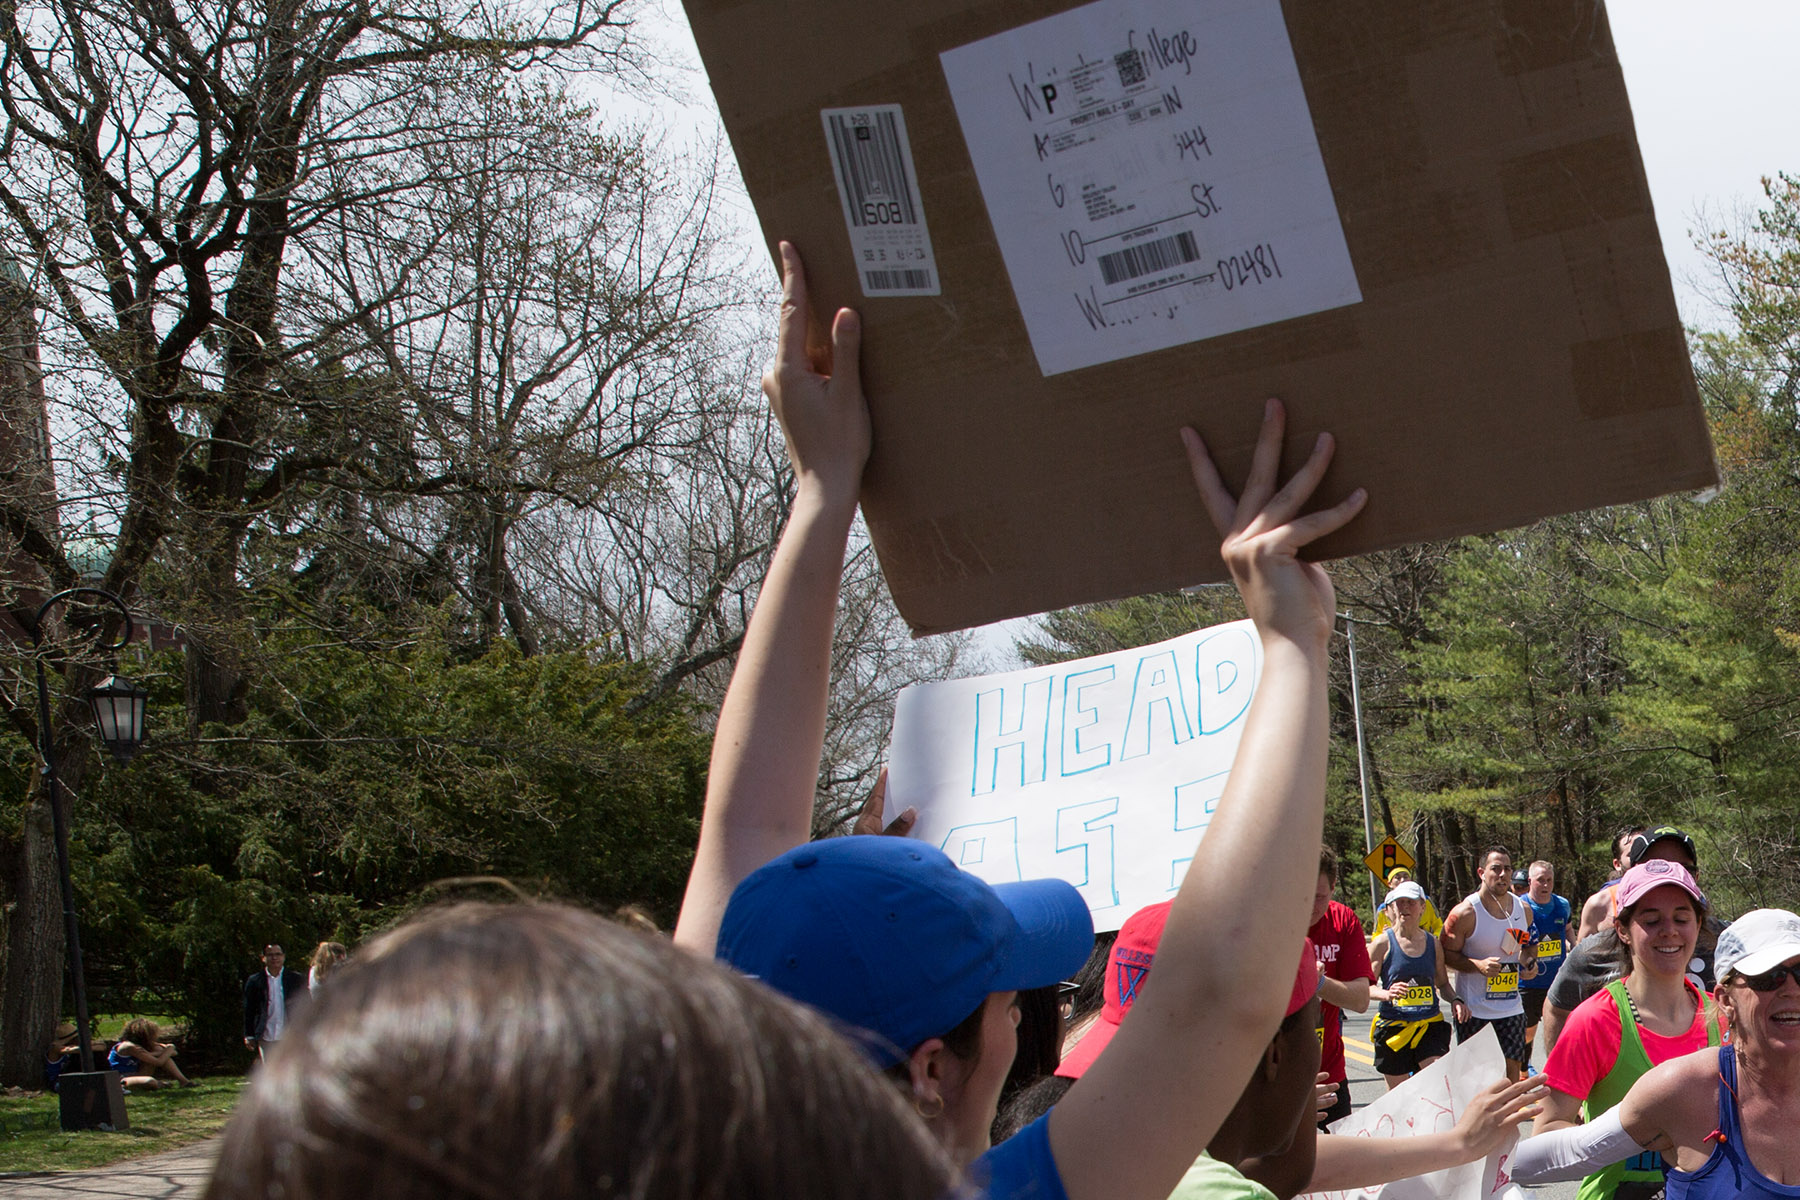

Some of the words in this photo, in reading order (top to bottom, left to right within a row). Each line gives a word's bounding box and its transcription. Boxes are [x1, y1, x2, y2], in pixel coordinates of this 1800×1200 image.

[1041, 84, 1057, 114] P
[1217, 243, 1282, 291] 02481
[971, 629, 1256, 796] HEAD
[1539, 941, 1561, 952] 8270
[1488, 974, 1517, 986] 30461
